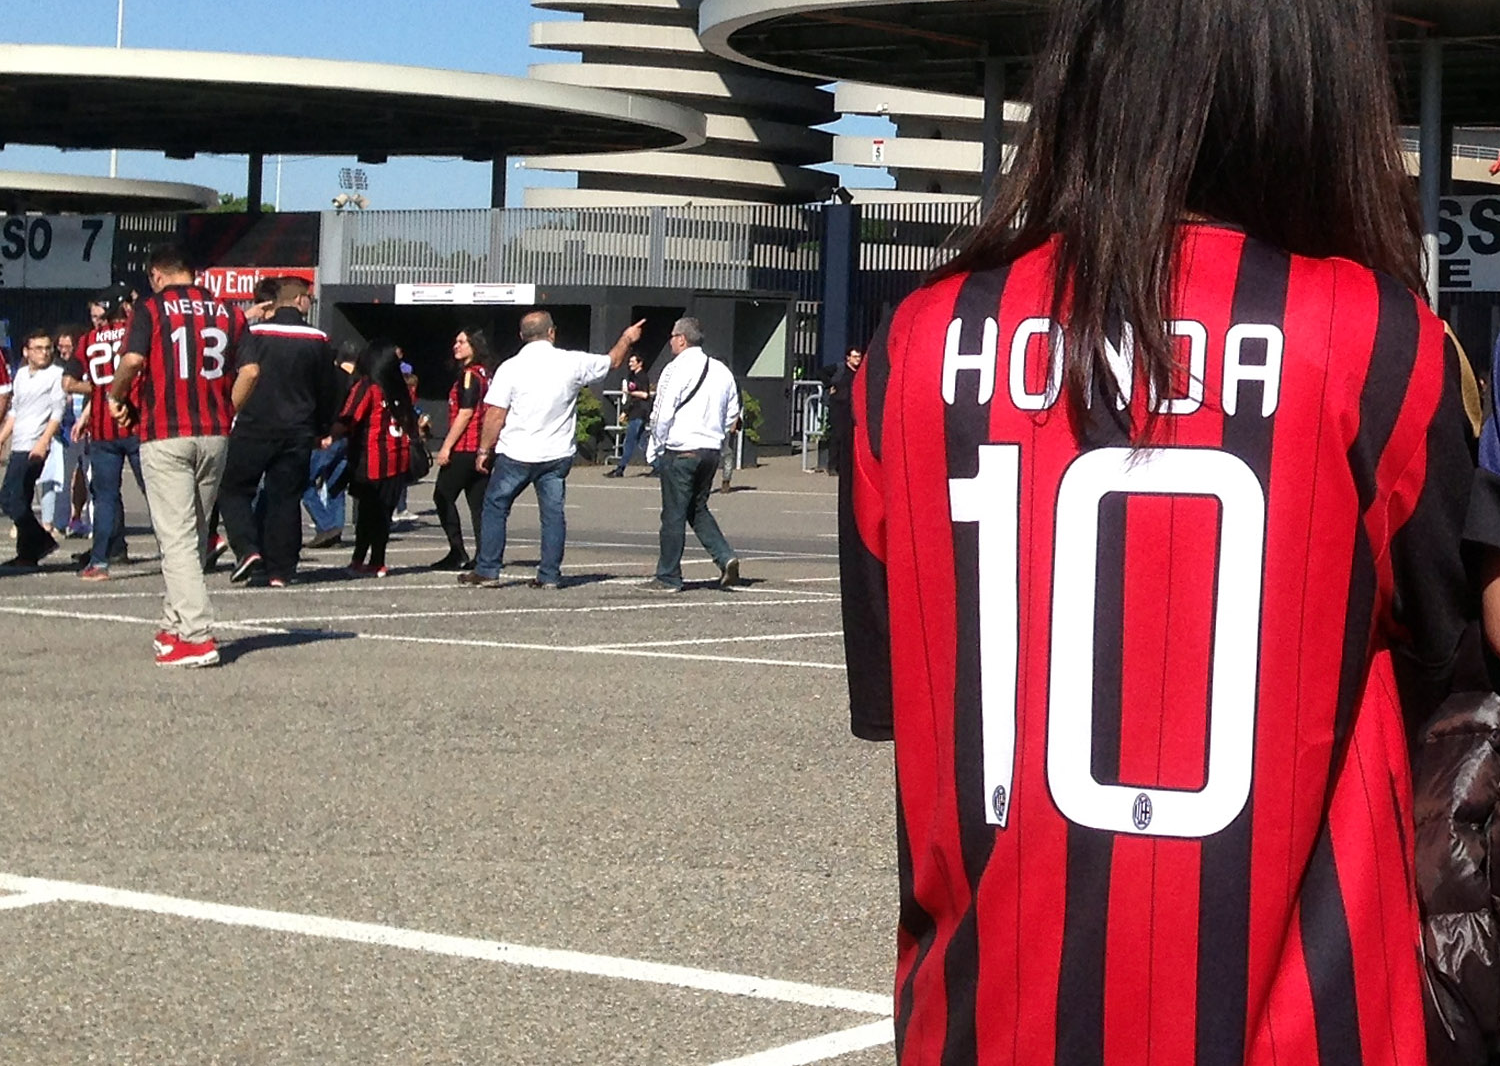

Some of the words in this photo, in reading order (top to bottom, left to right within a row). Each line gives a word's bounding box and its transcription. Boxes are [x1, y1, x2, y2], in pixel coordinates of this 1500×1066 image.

[1, 218, 52, 261] SO
[81, 219, 104, 262] 7
[163, 298, 229, 318] NESTA
[195, 270, 223, 297] ly
[170, 326, 228, 380] 13
[941, 316, 1285, 419] HONDA
[948, 443, 1267, 839] 10
